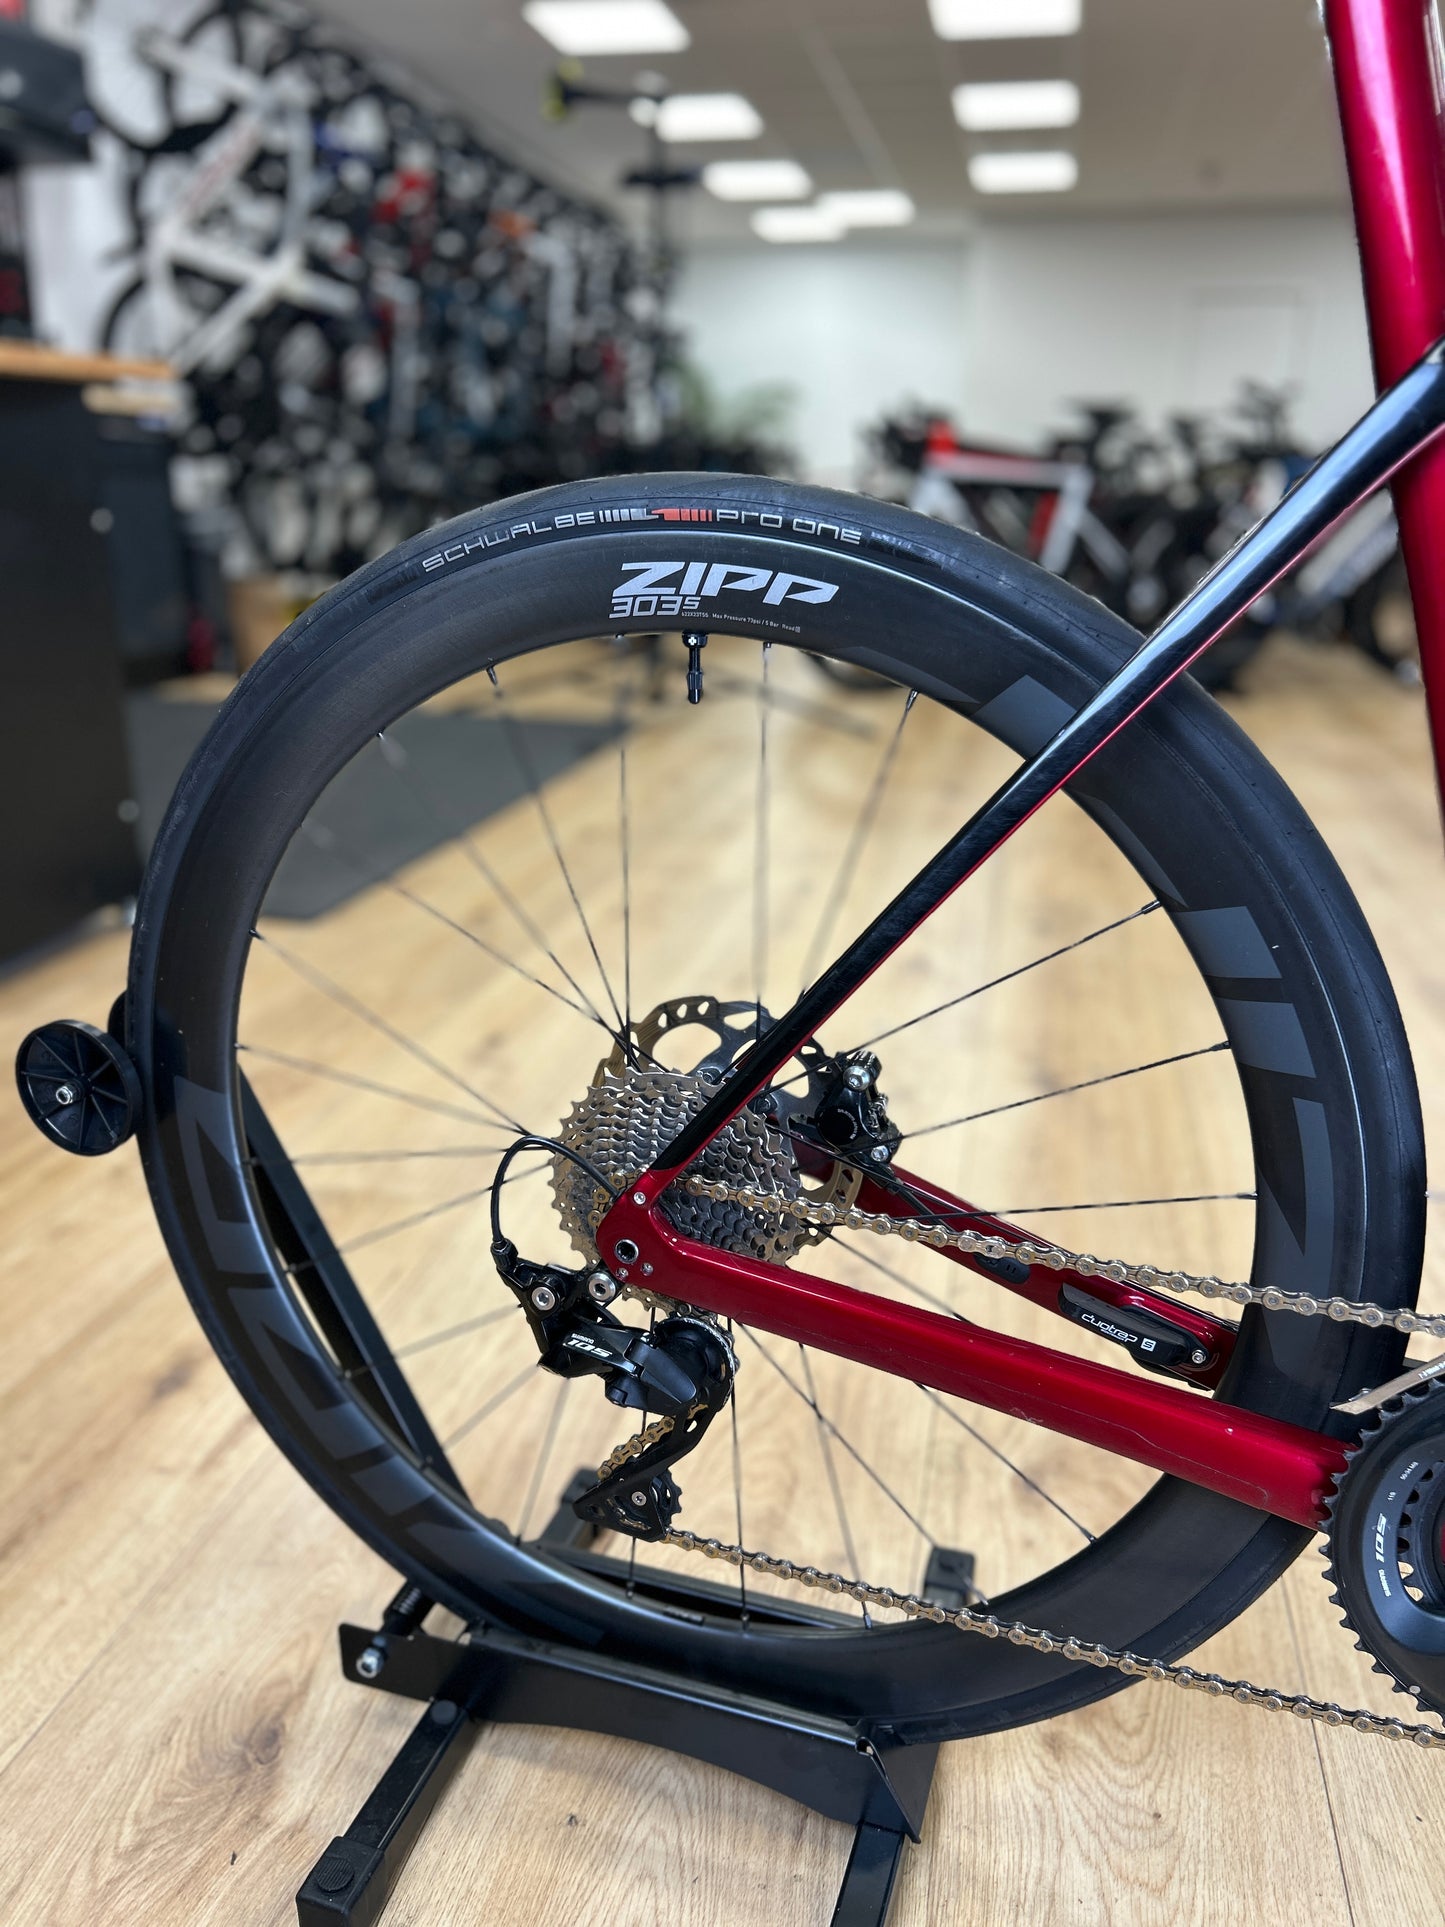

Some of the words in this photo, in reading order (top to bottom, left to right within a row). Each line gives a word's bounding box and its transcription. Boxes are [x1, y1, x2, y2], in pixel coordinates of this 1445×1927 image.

[421, 511, 596, 573] SCHWALBE
[612, 561, 840, 606] ZIPP
[723, 614, 747, 622] Pressure
[567, 1339, 613, 1358] 105
[1081, 1313, 1139, 1342] duotrap
[1141, 1339, 1156, 1351] S
[1375, 1512, 1387, 1563] 105
